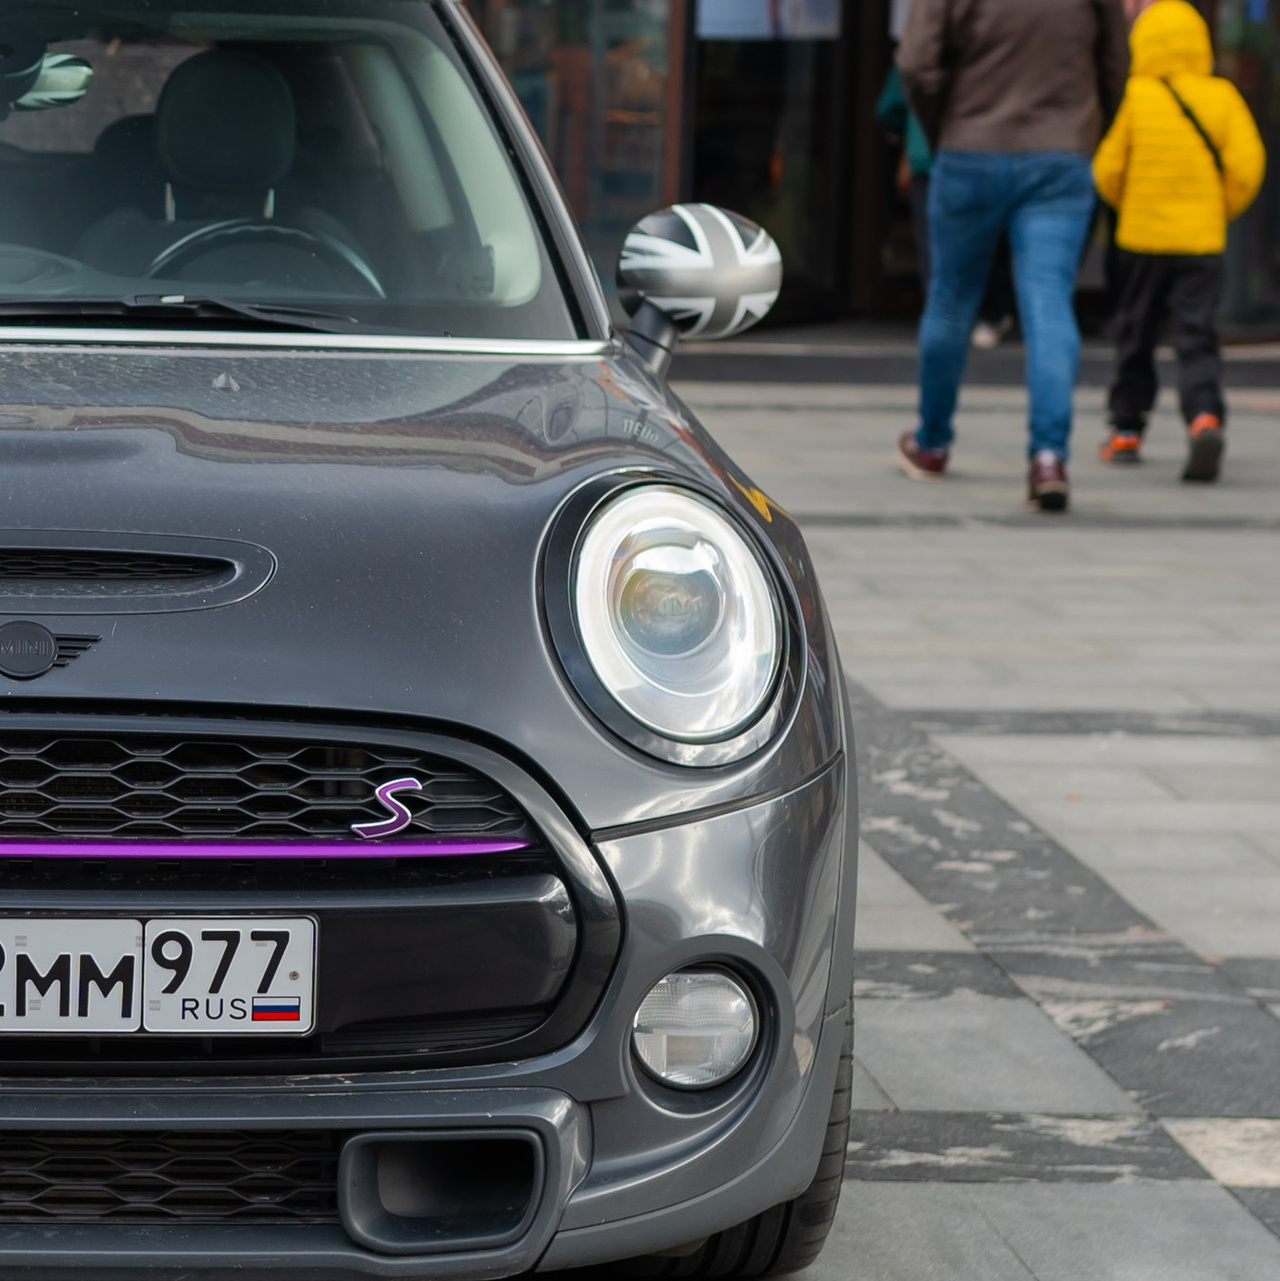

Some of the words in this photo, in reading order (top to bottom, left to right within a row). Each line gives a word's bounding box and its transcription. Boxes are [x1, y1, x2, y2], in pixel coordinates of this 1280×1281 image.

[351, 777, 423, 838] S
[151, 930, 291, 994] 977
[181, 998, 247, 1020] RUS
